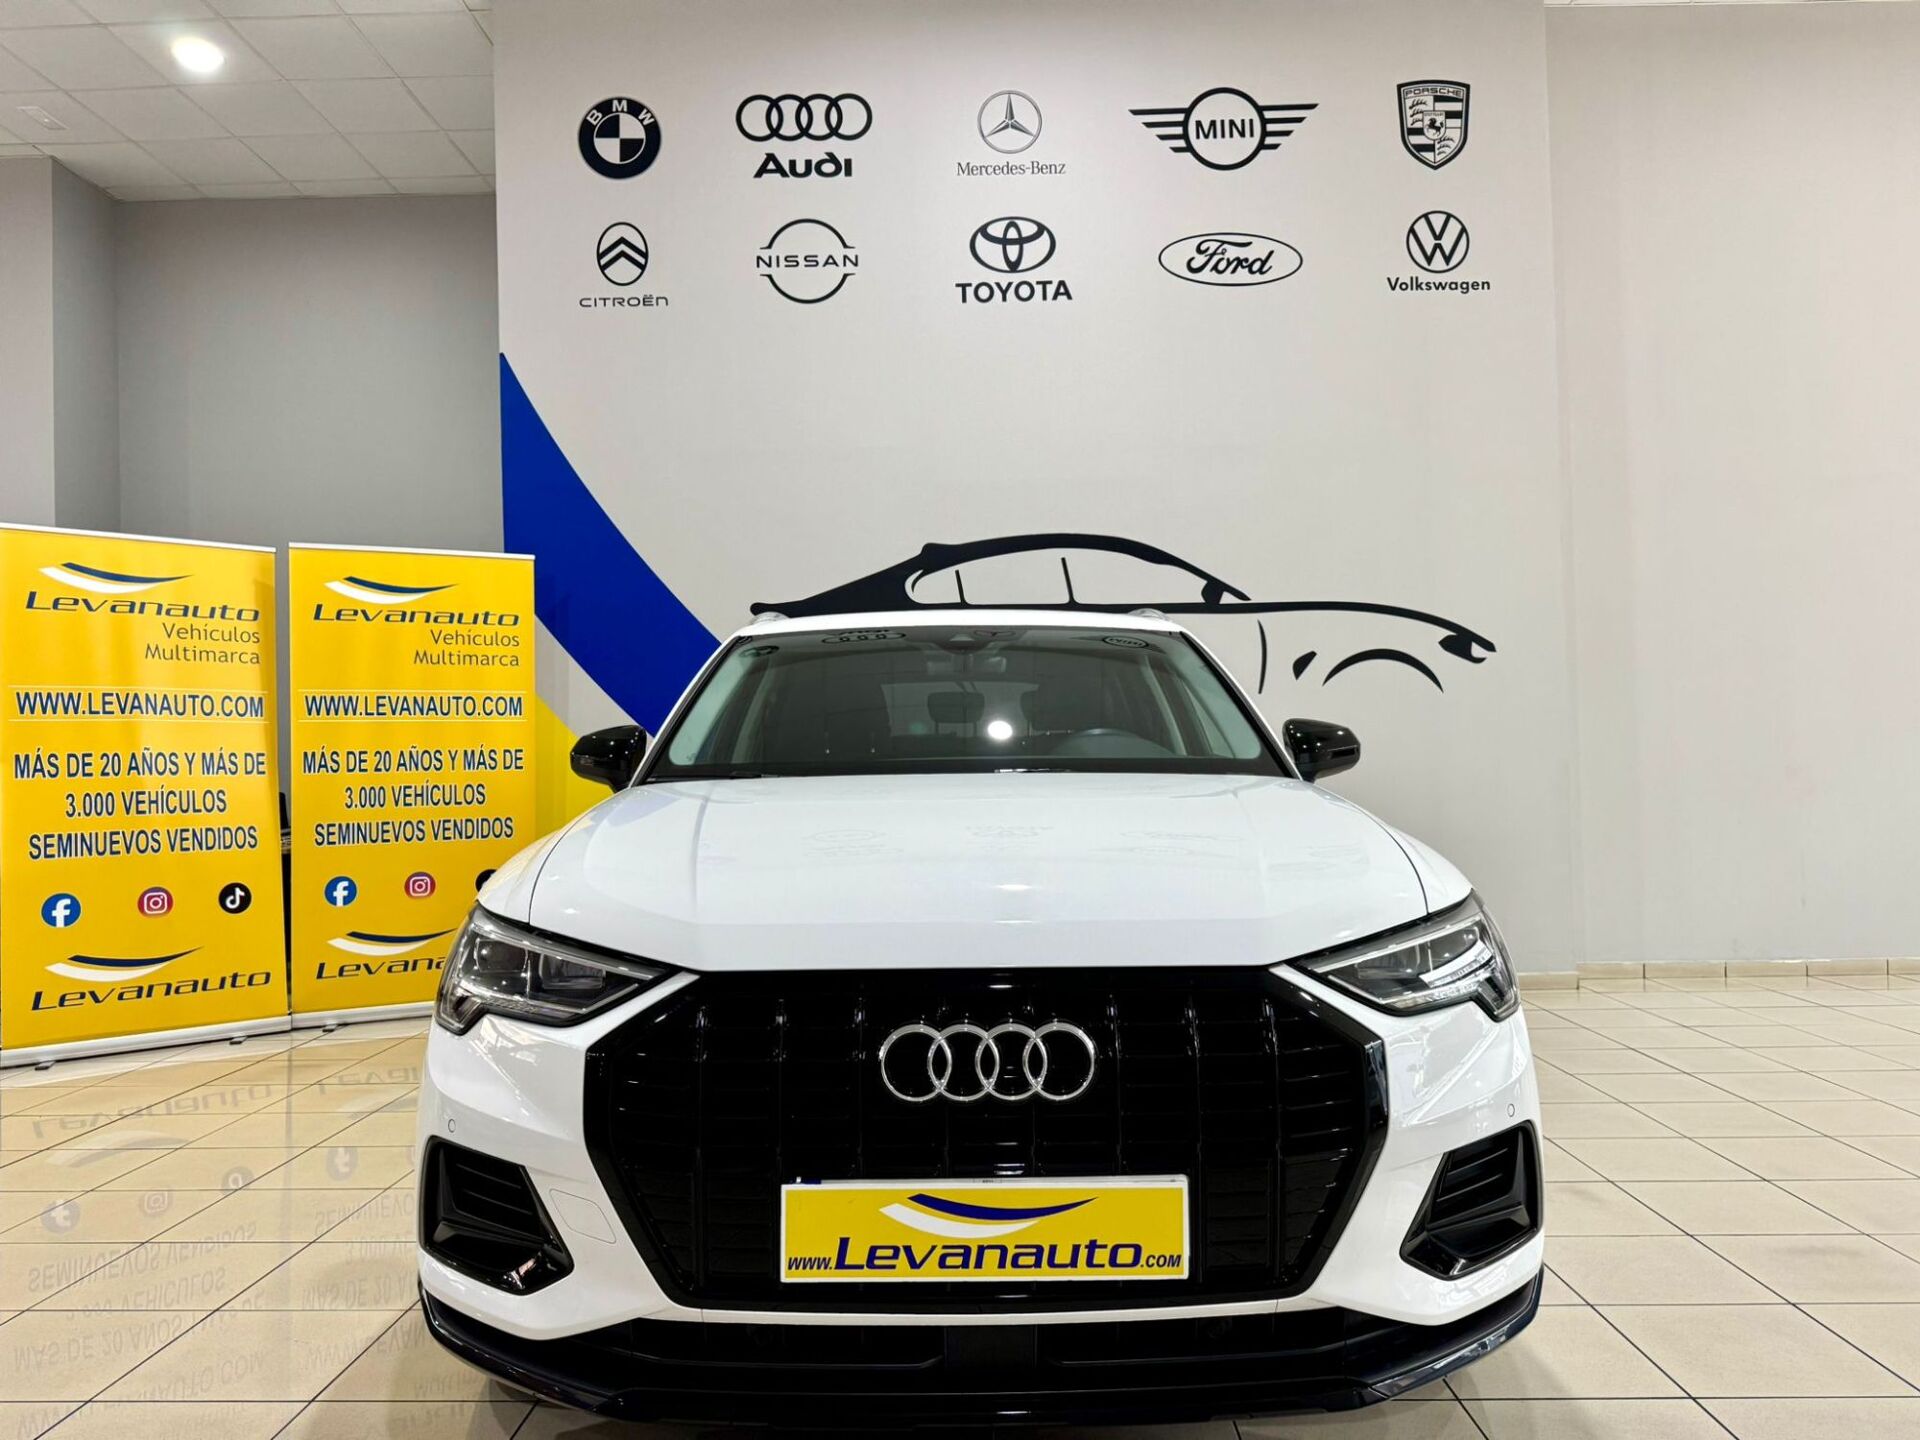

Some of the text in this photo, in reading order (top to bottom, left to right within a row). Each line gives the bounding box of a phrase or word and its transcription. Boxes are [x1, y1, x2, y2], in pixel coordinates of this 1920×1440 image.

[1405, 87, 1462, 97] PORSCHE
[586, 99, 655, 126] BMW
[1195, 118, 1254, 139] MINI
[753, 152, 852, 178] Audi
[957, 160, 1066, 176] Mercedes-Benz
[756, 254, 859, 268] NISSAN
[1186, 238, 1274, 275] Ford
[955, 279, 1073, 304] TOYOTA
[1387, 276, 1491, 294] Volkswagen
[26, 591, 260, 622] Levanauto
[313, 603, 520, 627] Levanauto
[162, 622, 261, 644] Vehículos
[430, 629, 520, 647] Vehículos
[144, 643, 261, 665] Multimarca
[413, 650, 520, 667] Multimarca
[15, 691, 264, 718] WWW.LEVANAUTO.COM
[305, 695, 523, 717] WWW.LEVANAUTO.COM
[14, 747, 266, 779] MÁS DE 20 AÑOS Y MÁS DE
[303, 744, 524, 774] MÁS DE 20 AÑOS Y MÁS DE
[65, 785, 227, 818] 3.000 VEHÍCULOS
[344, 780, 486, 809] 3.000 VEHÍCULOS
[29, 825, 258, 860] SEMINUEVOS VENDIDOS
[314, 817, 514, 846] SEMINUEVOS VENDIDOS
[31, 971, 271, 1011] Levanauto
